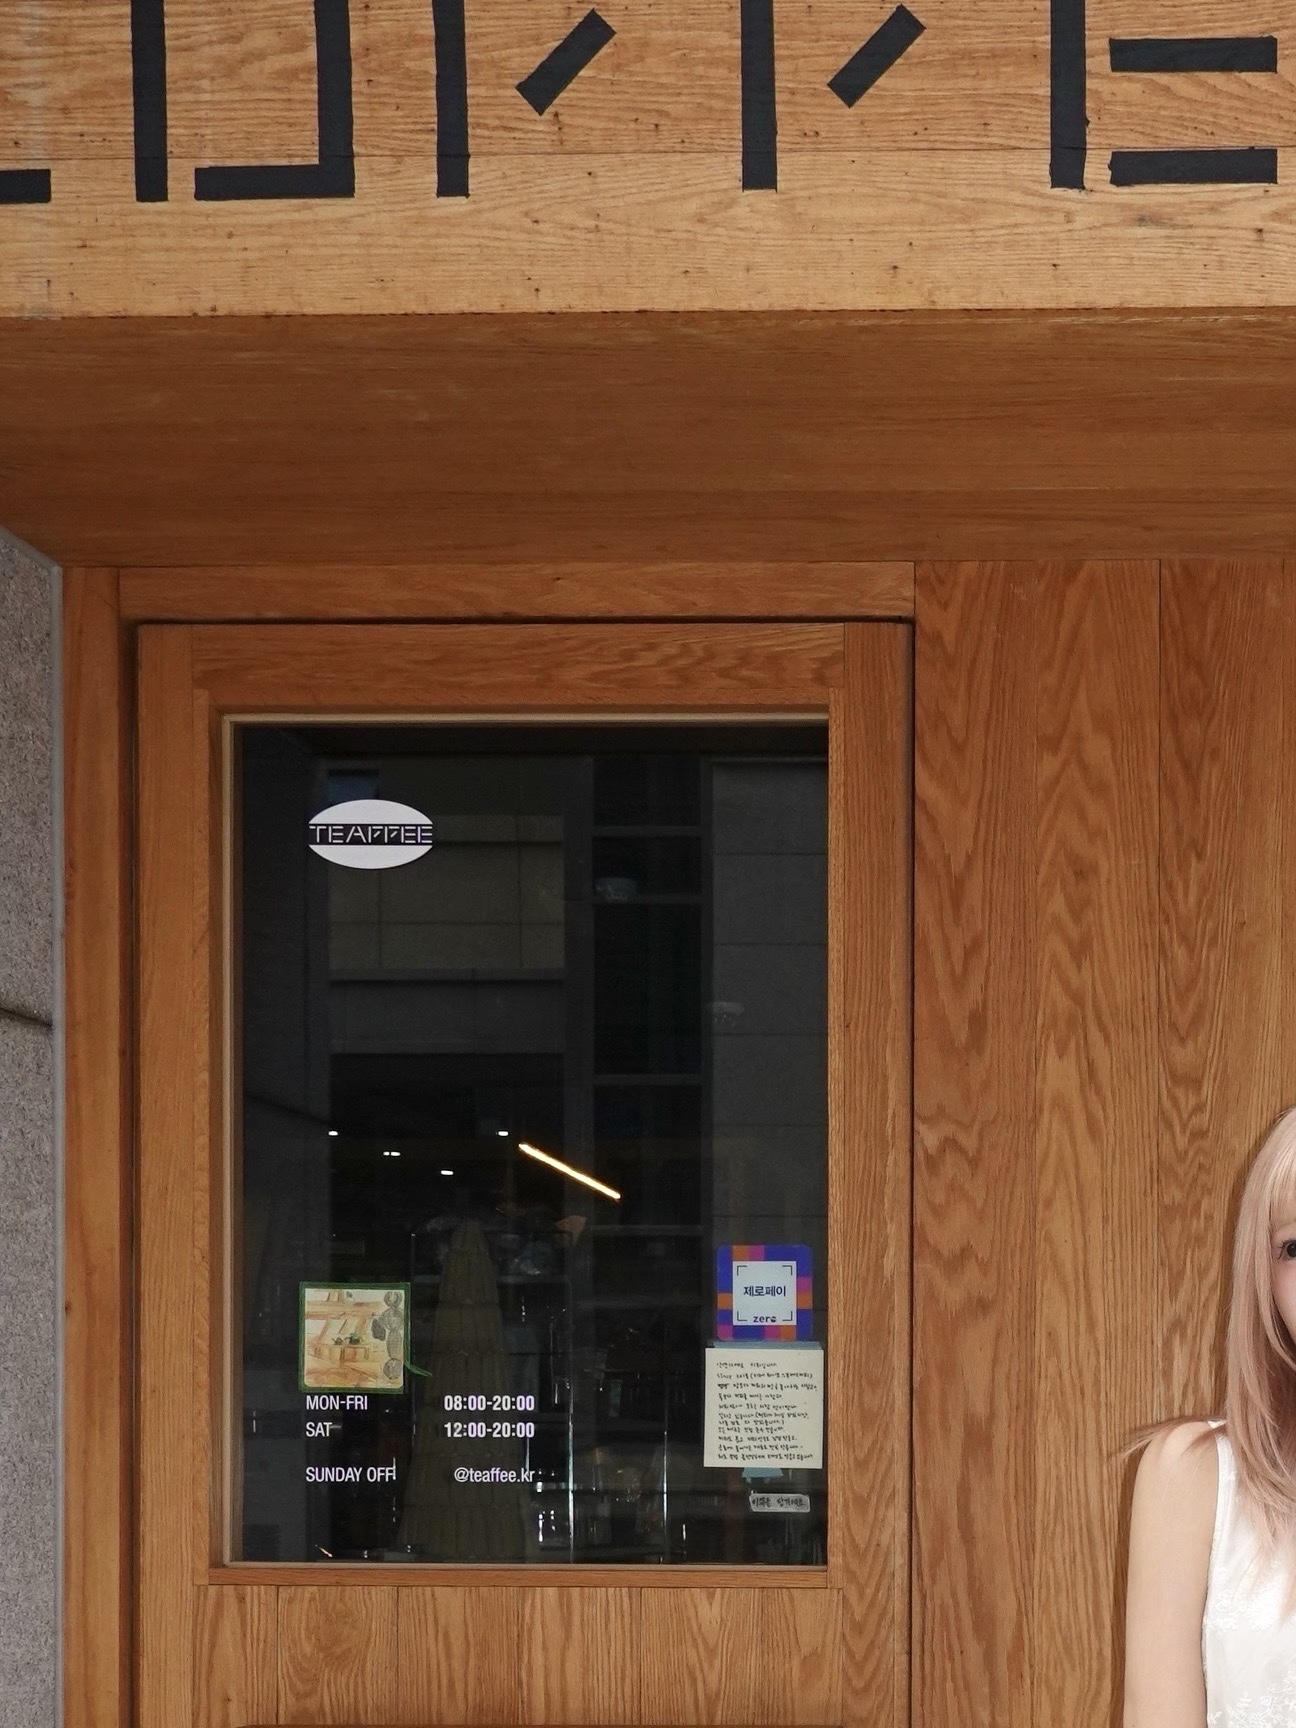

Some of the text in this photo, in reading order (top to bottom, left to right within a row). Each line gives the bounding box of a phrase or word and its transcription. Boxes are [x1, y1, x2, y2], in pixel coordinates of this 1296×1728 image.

[308, 825, 433, 844] TEAFFEE
[743, 1285, 787, 1297] 제로페이
[753, 1315, 777, 1323] zero
[305, 1395, 368, 1411] MON-FRI
[443, 1395, 535, 1411] 08:00-20:00
[305, 1421, 333, 1438] SAT
[443, 1421, 535, 1438] 12:00-20:00
[305, 1467, 396, 1482] SUNDAY OFF
[453, 1466, 536, 1483] @teaffee.kr
